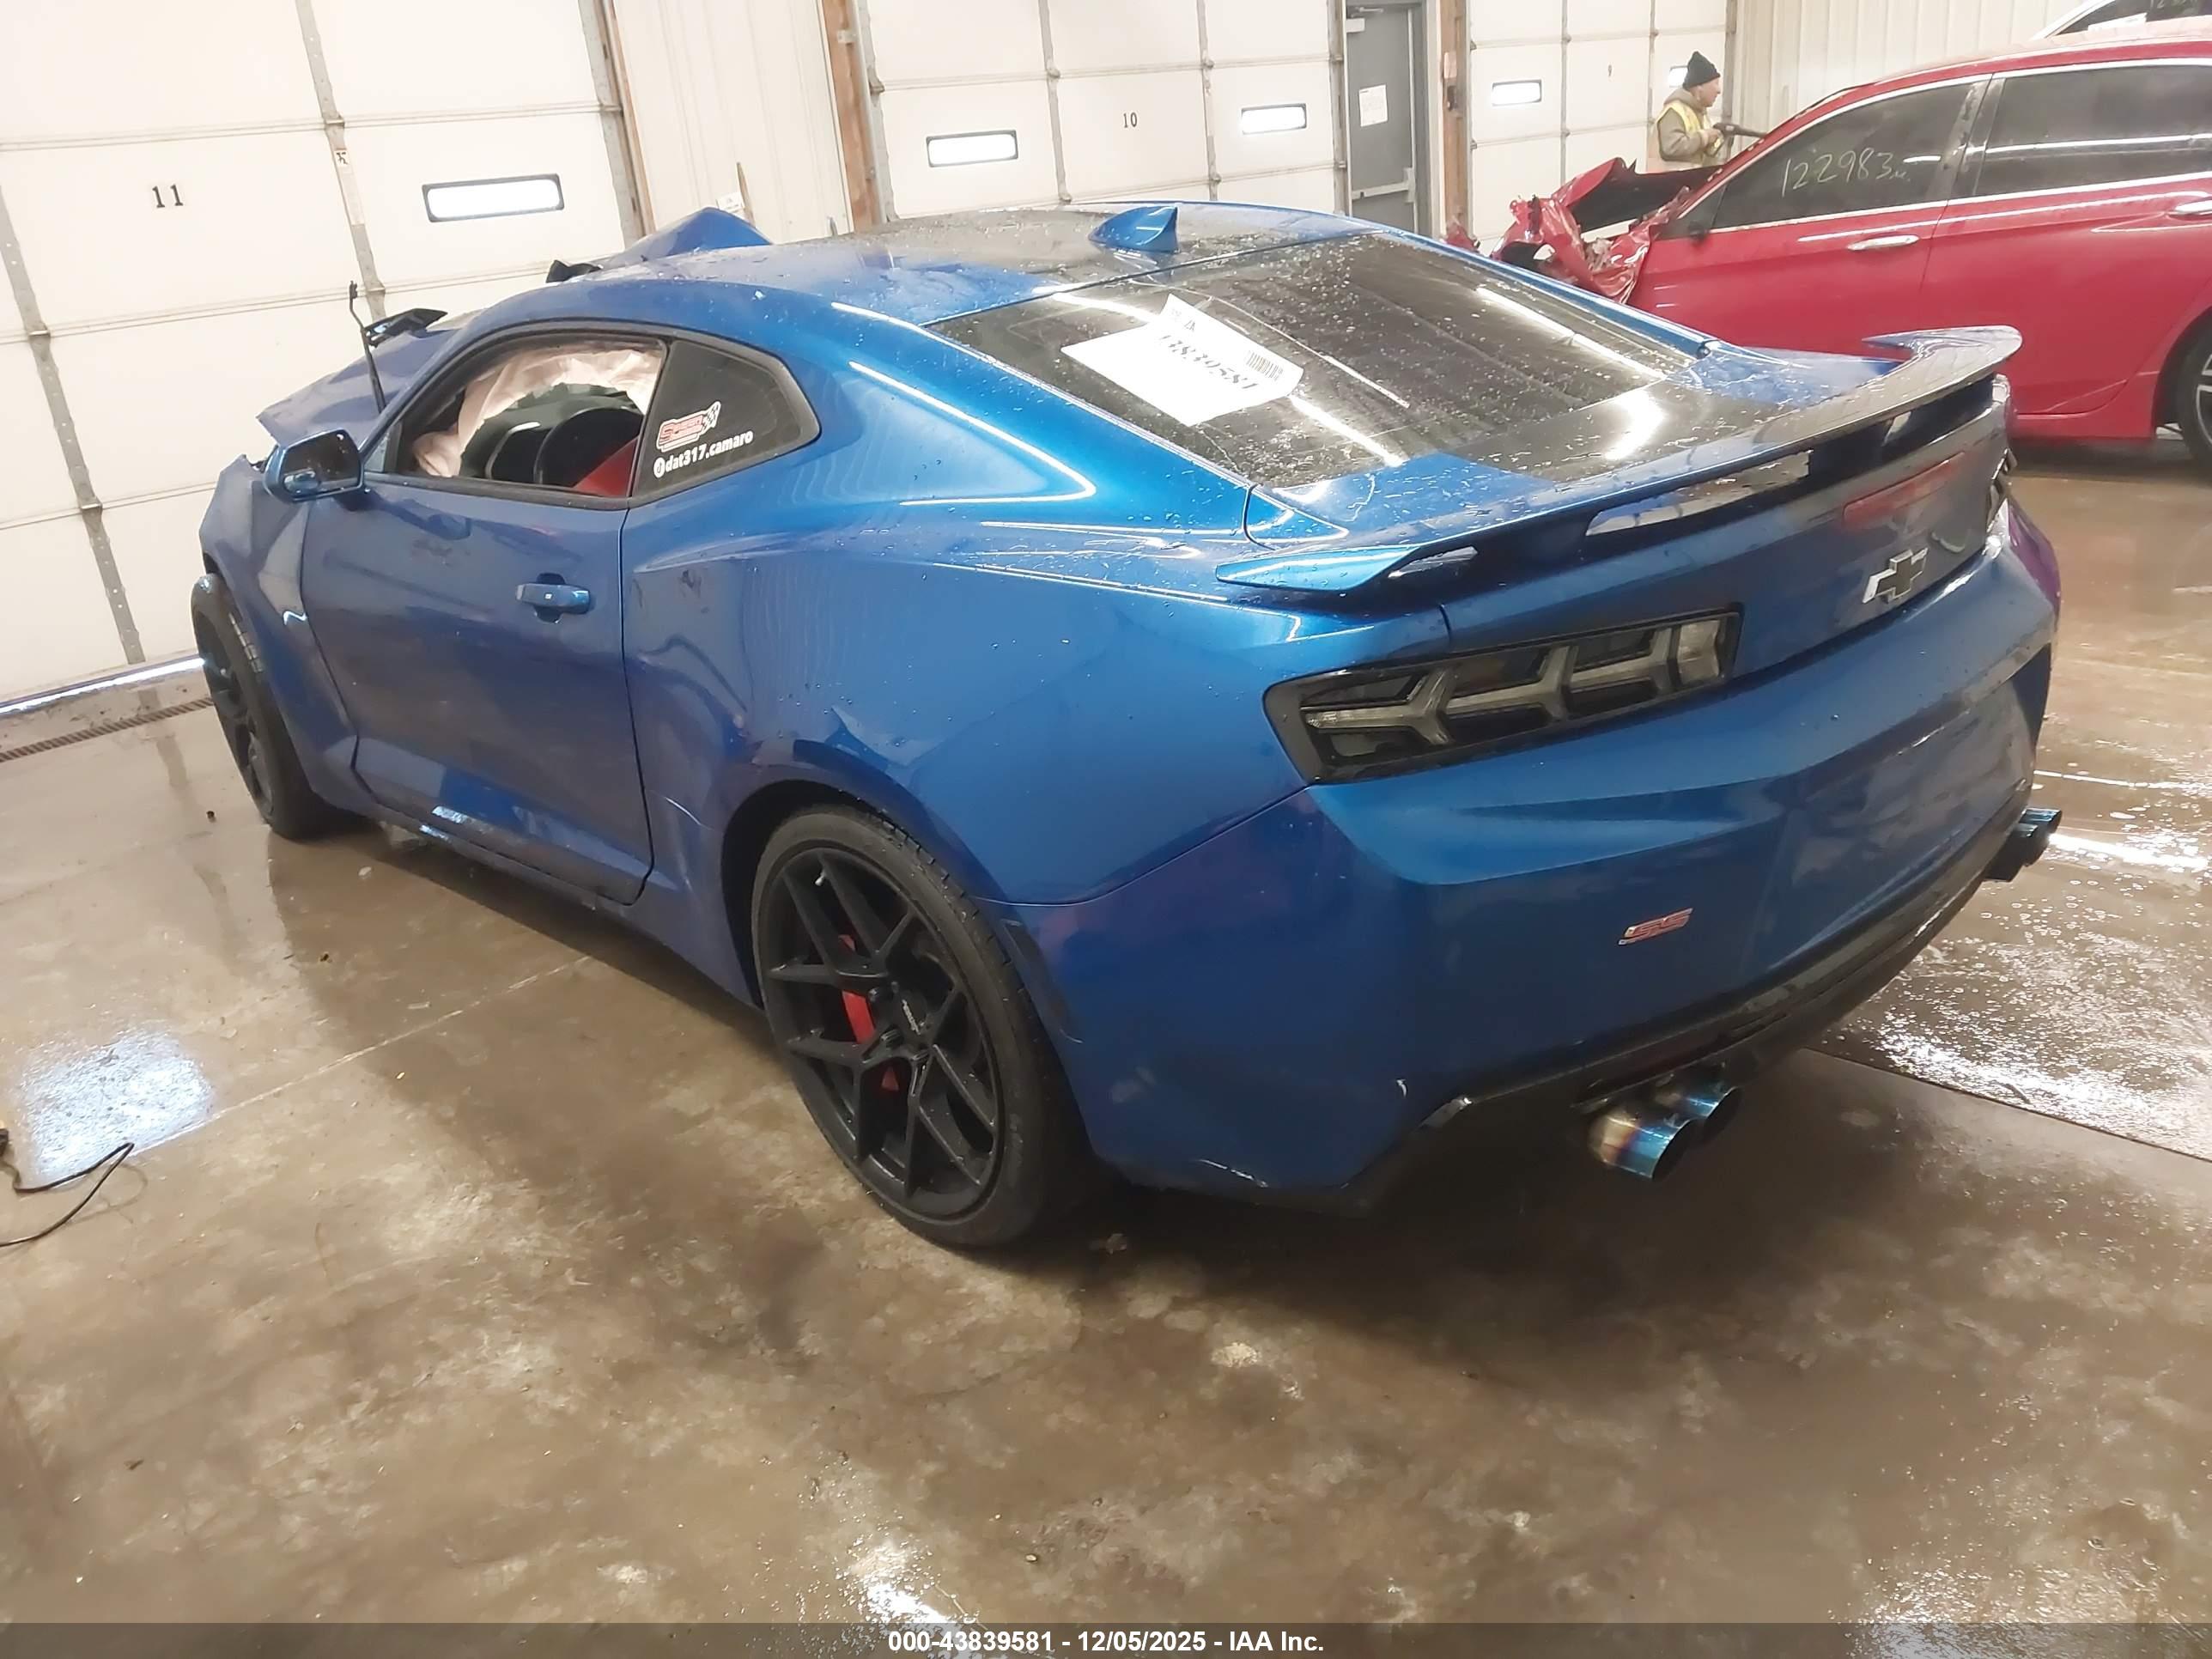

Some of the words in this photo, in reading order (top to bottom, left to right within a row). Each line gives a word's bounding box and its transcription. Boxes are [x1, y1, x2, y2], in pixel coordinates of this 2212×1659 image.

[1123, 112, 1138, 128] 10
[152, 184, 184, 209] 11
[1618, 908, 1694, 945] SS
